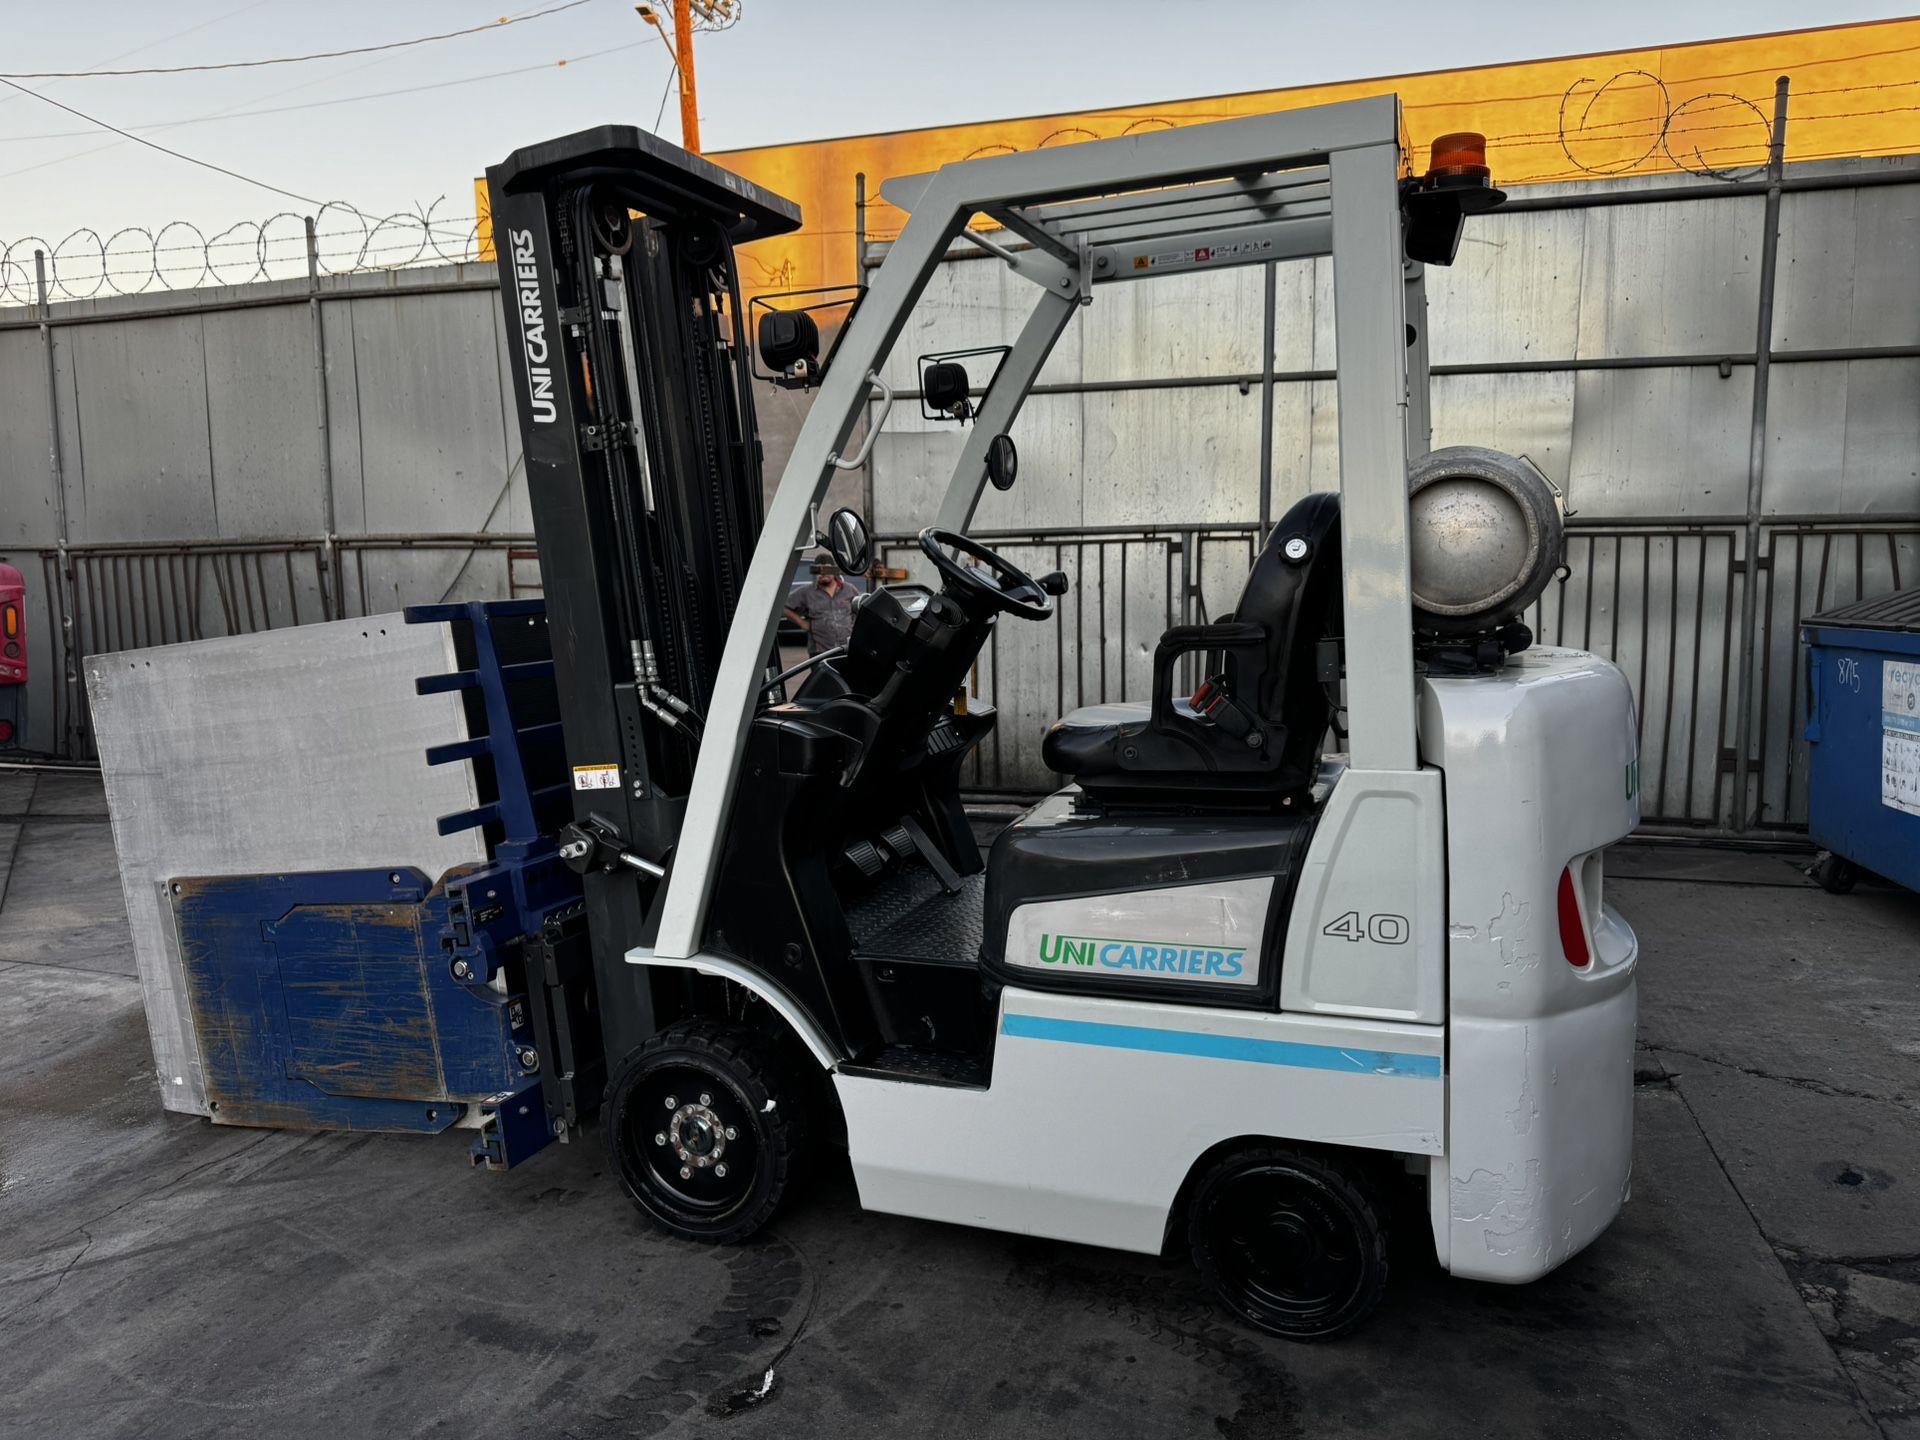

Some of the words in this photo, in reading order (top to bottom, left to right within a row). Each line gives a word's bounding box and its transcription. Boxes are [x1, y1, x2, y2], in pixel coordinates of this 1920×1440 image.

[509, 228, 557, 423] UNICARRIERS
[1323, 911, 1410, 945] 40
[1039, 933, 1247, 978] UNICARRIERS
